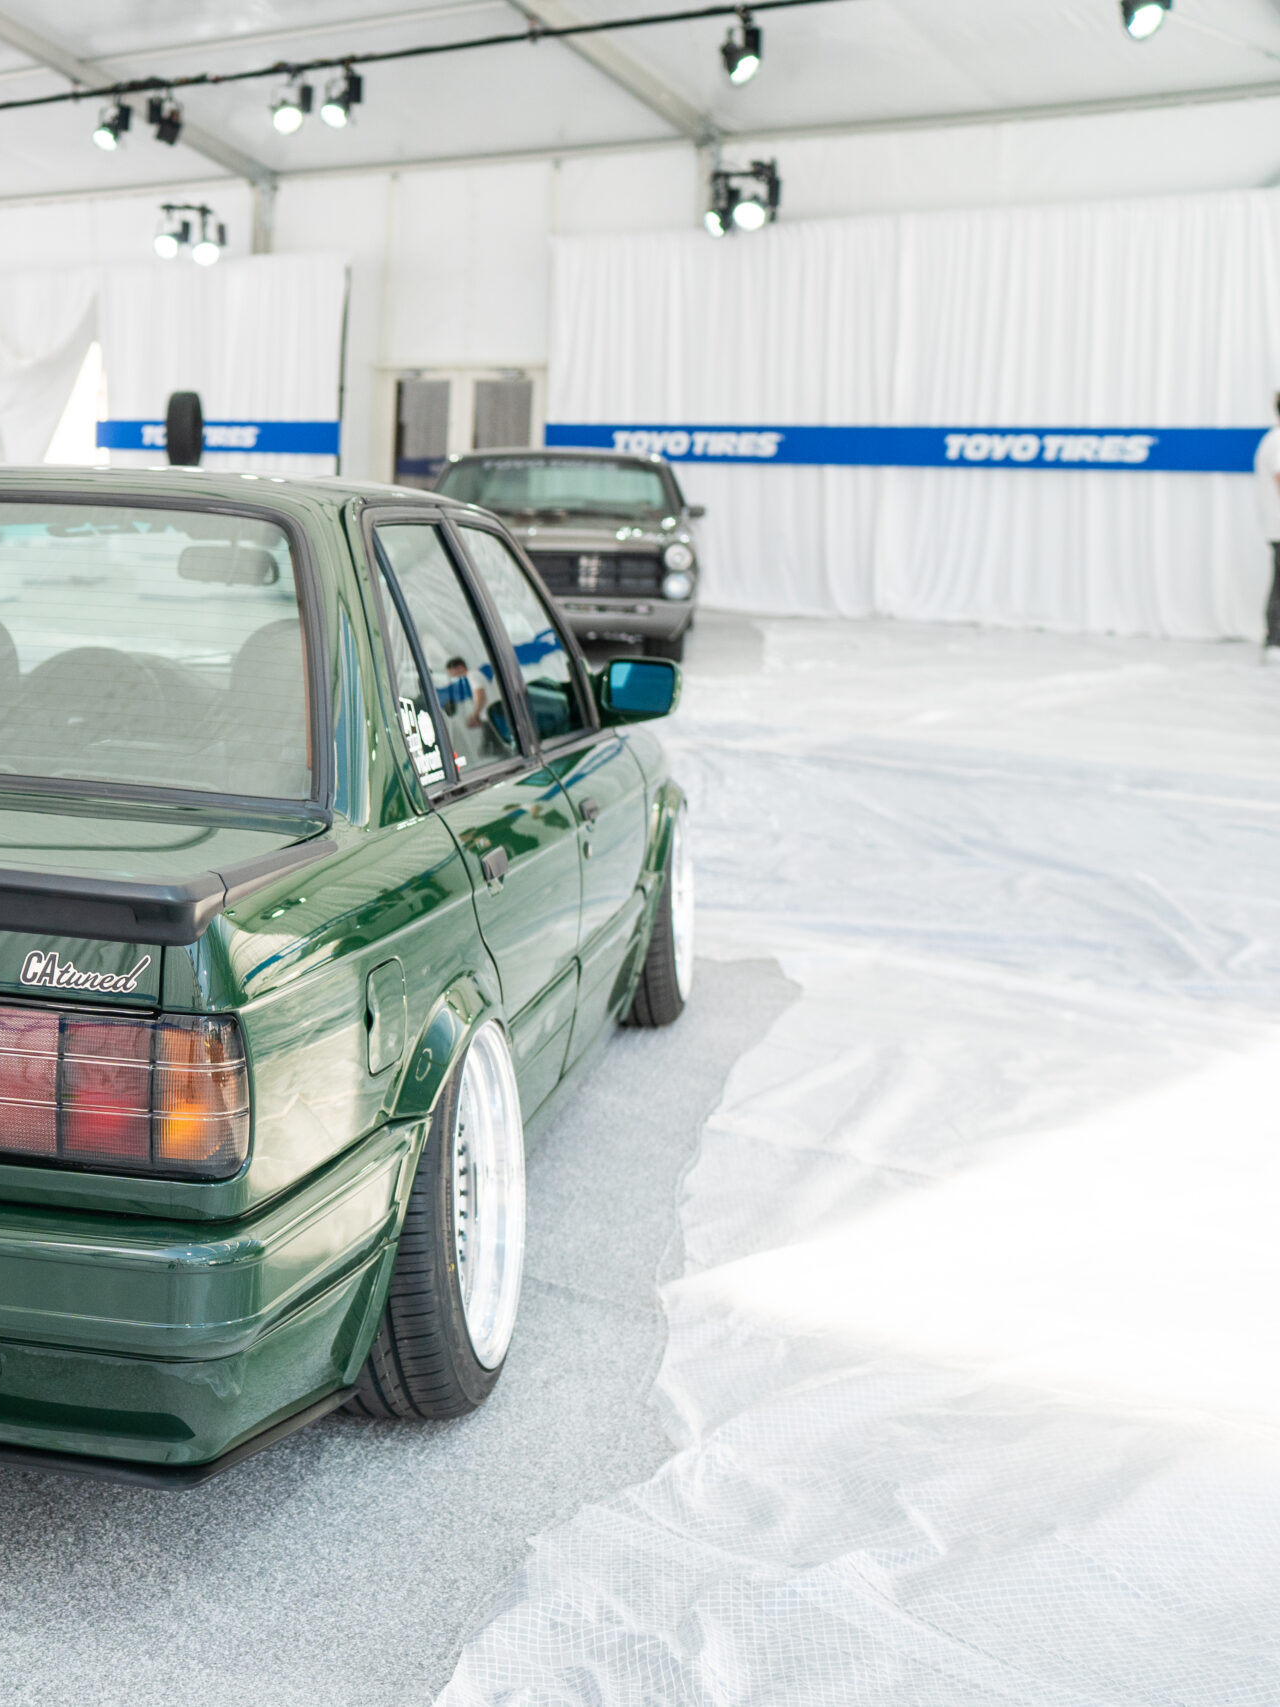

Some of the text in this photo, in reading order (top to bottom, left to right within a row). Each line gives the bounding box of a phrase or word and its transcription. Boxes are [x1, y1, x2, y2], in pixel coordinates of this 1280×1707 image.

[612, 430, 780, 457] TOYO TIRES
[944, 433, 1152, 463] TOYO TIRES
[20, 950, 151, 993] CAtuned
